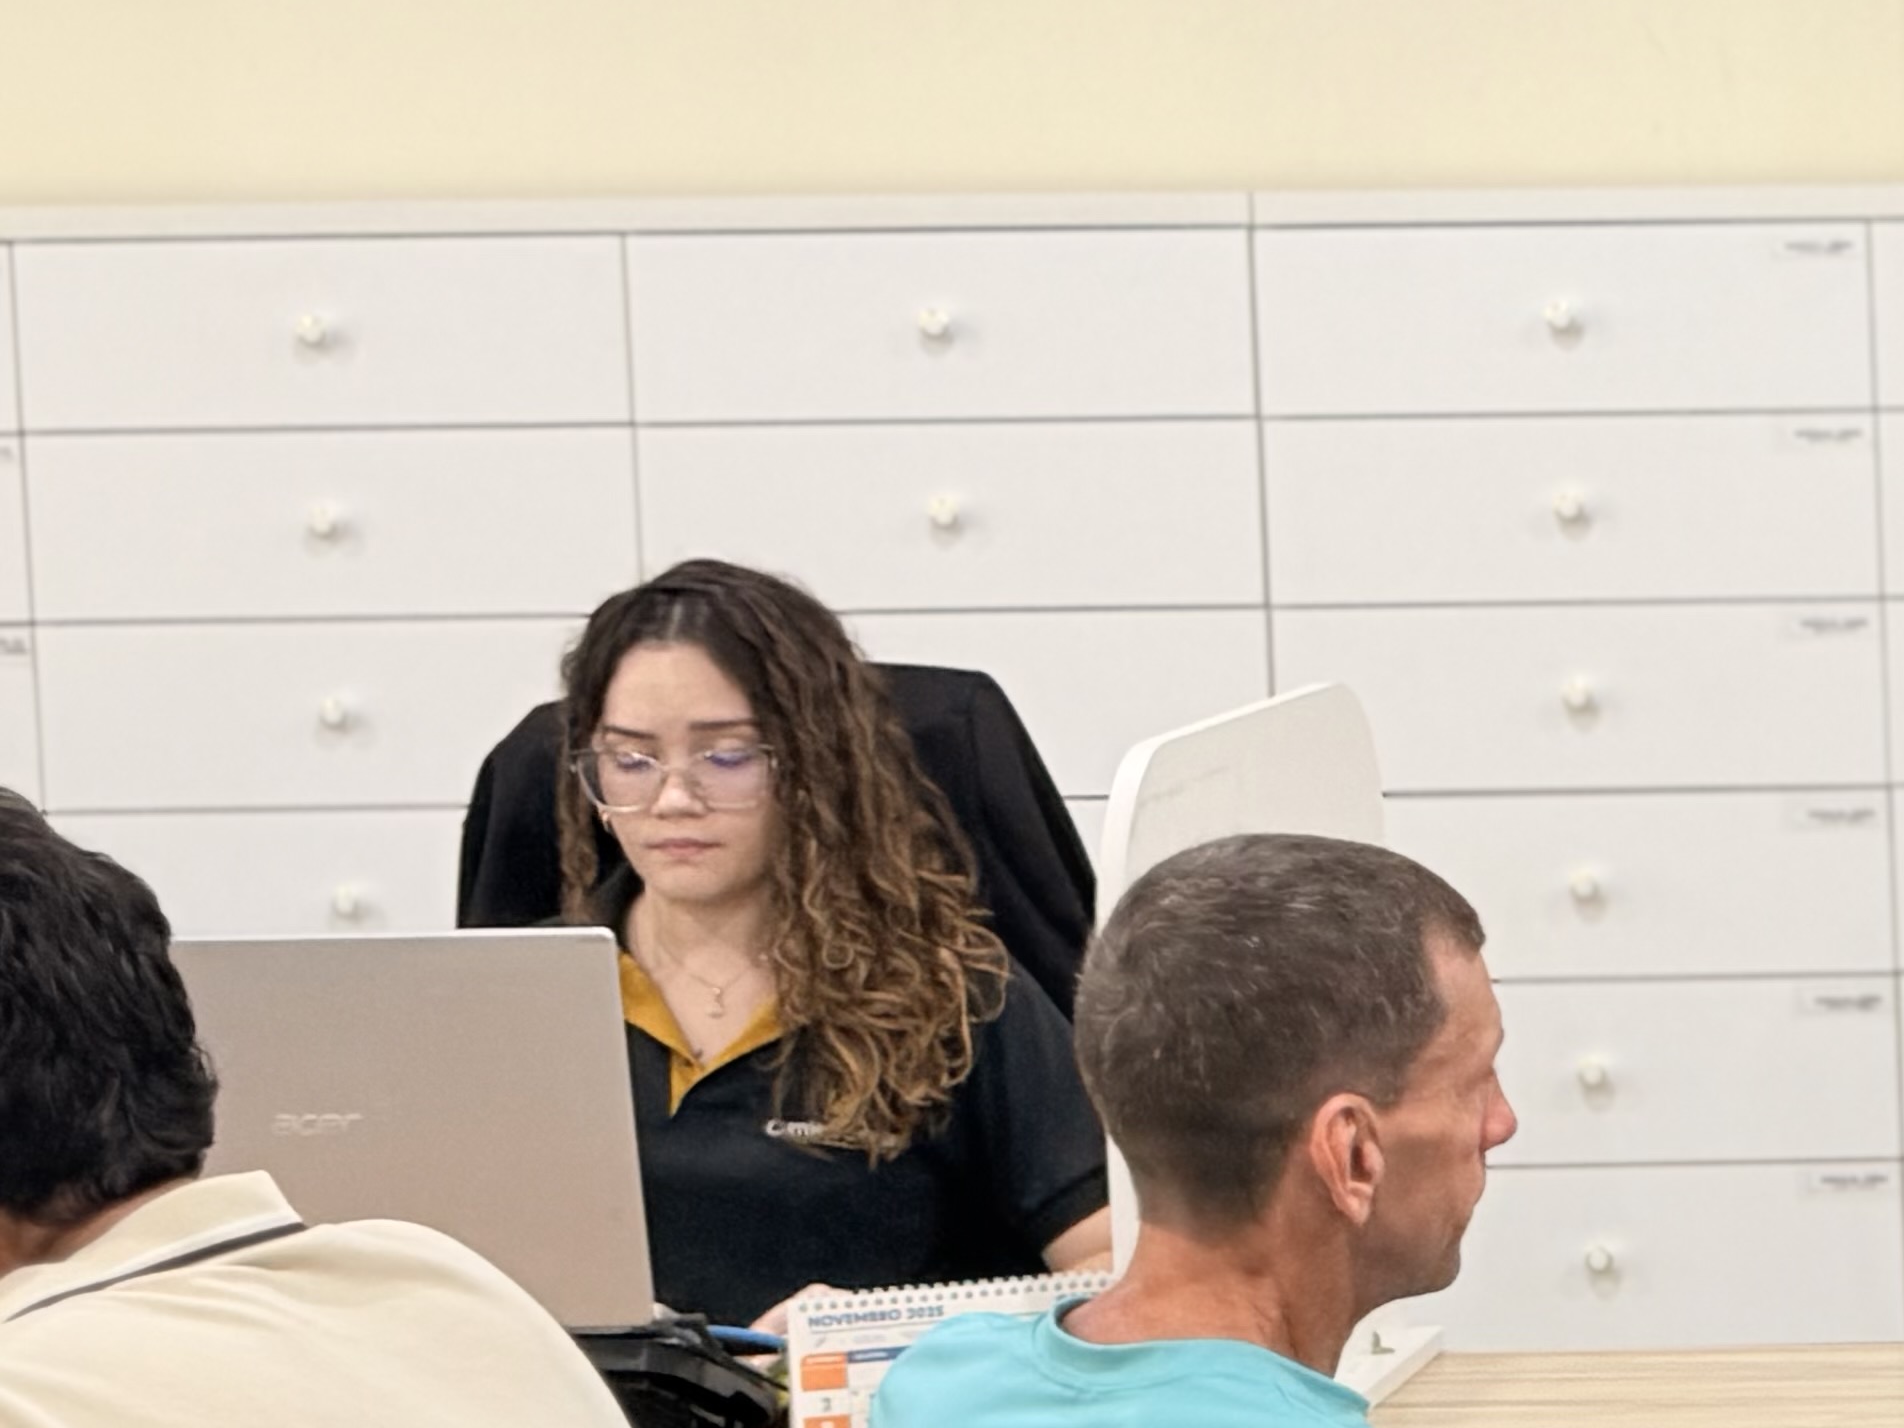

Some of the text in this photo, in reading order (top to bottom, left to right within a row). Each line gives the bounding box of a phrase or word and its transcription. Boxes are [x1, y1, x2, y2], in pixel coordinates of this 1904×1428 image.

[271, 1113, 364, 1137] acer
[807, 1305, 945, 1328] NOVEMBRO 2025
